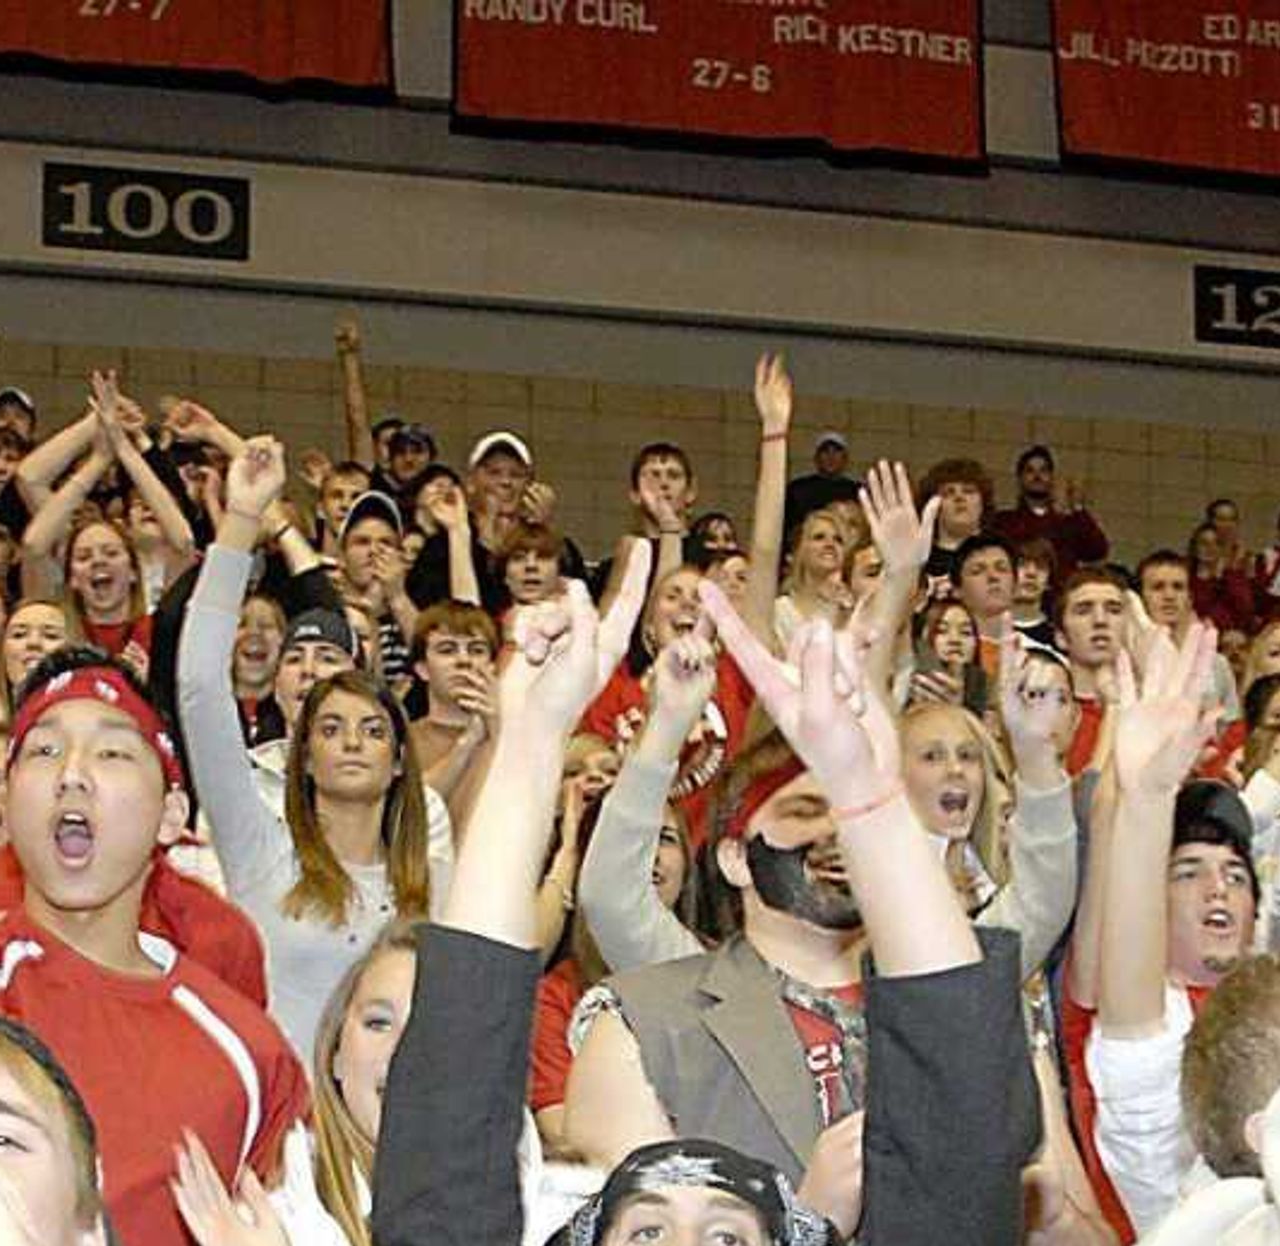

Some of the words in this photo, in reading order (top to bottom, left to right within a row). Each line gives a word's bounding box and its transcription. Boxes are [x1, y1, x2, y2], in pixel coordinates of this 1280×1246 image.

[576, 0, 658, 32] CURL
[838, 24, 971, 65] KESTNER
[692, 58, 770, 92] 27-6
[57, 182, 233, 244] 100
